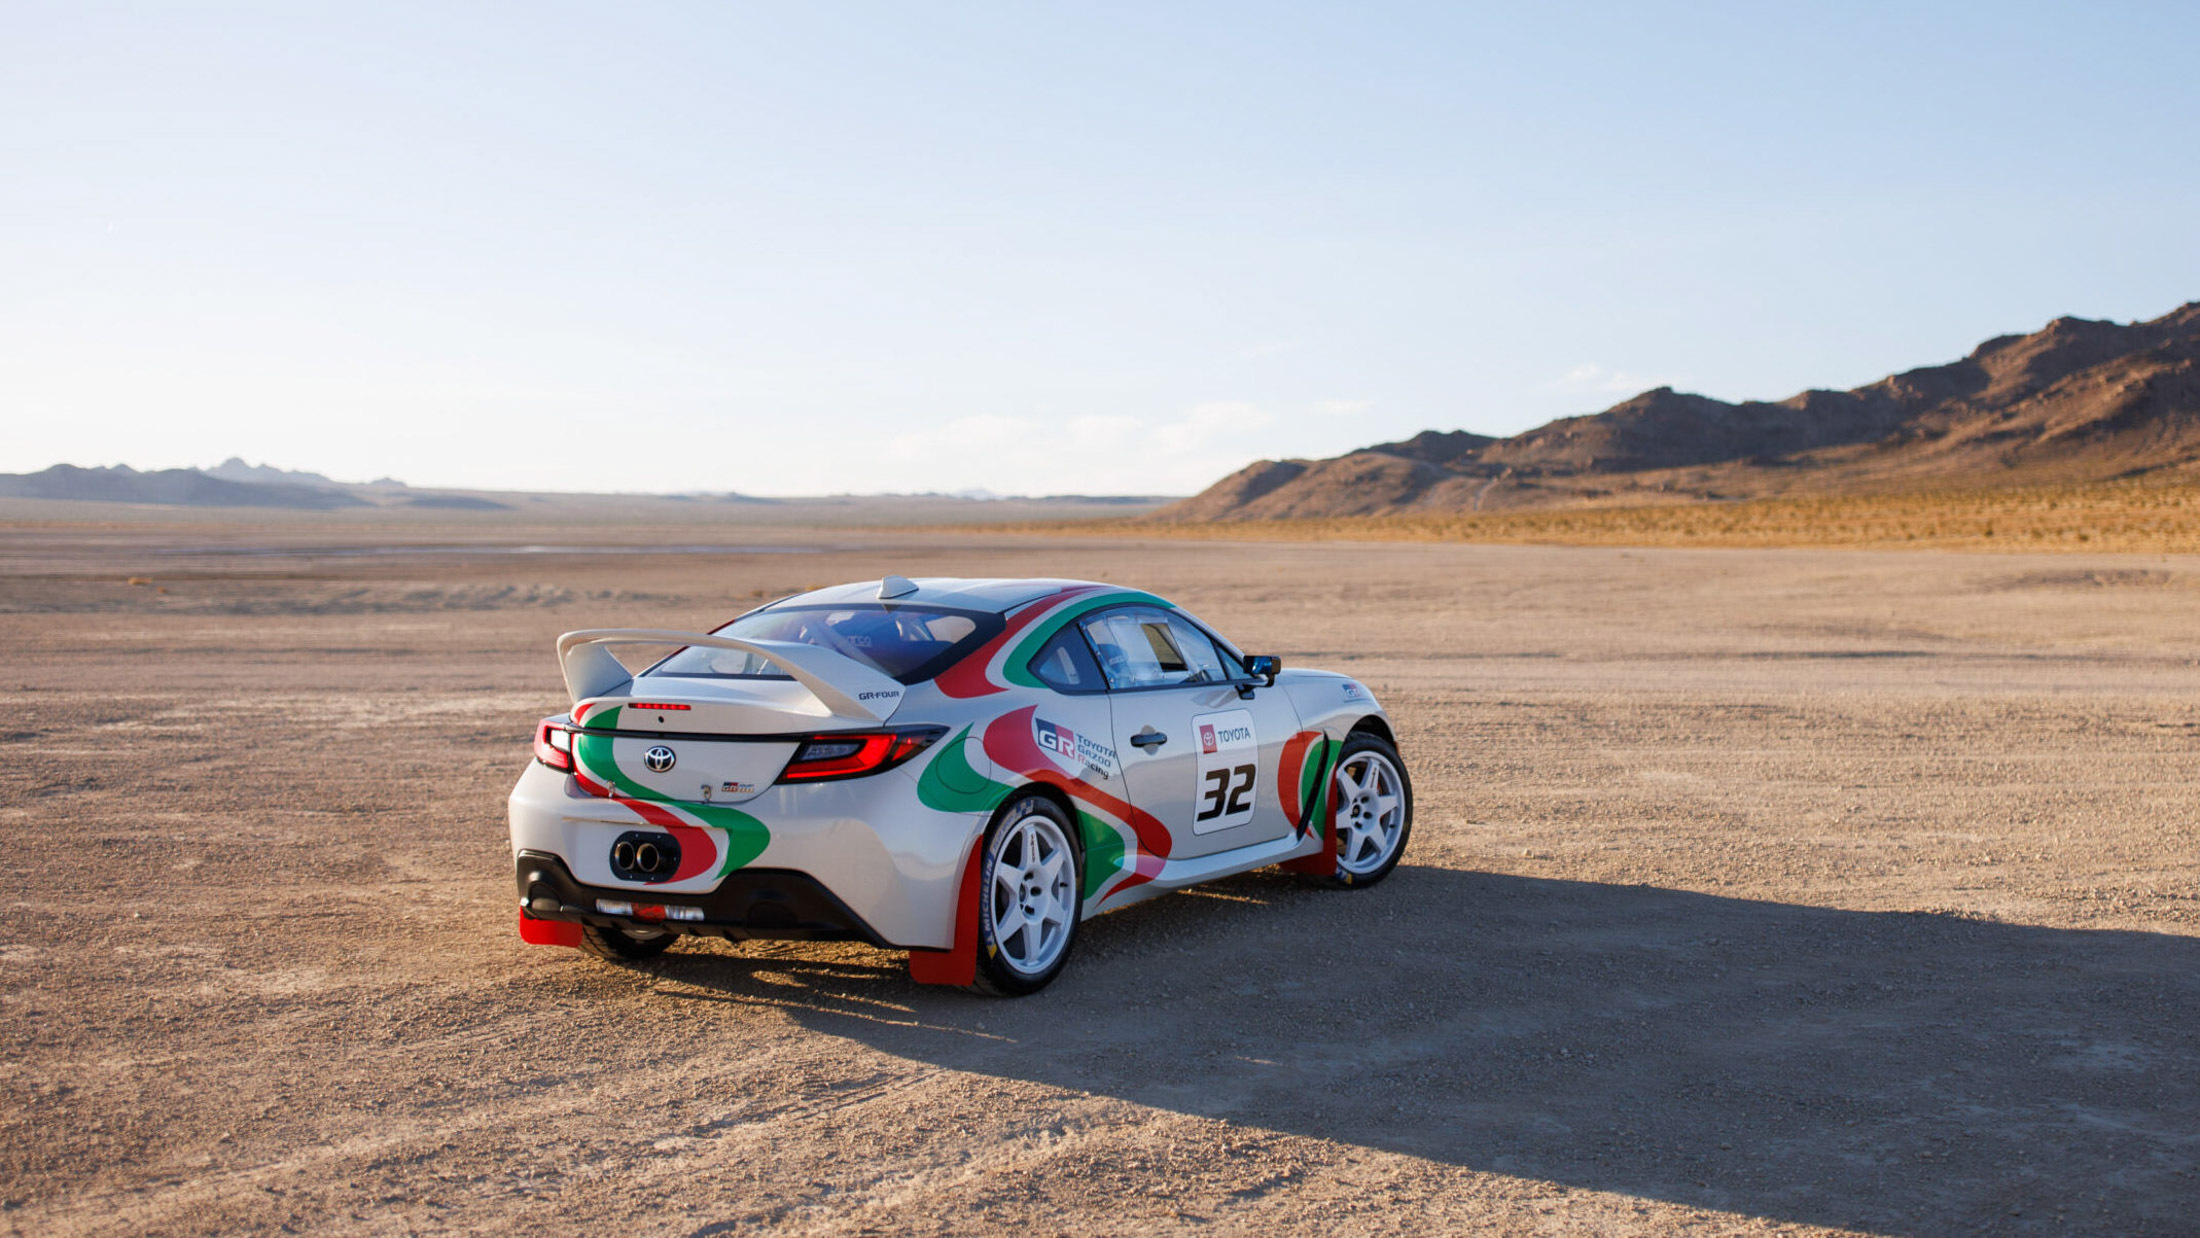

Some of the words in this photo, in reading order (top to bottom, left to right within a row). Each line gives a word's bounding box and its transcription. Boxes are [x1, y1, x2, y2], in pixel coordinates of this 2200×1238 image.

[858, 691, 900, 701] GR-FOUR
[1039, 729, 1074, 760] GR
[1076, 733, 1116, 759] TOYOTA
[1217, 727, 1251, 742] TOYOTA
[1077, 744, 1111, 768] GAZOO
[1077, 753, 1109, 780] Racing
[1196, 763, 1256, 822] 32
[982, 858, 993, 930] MICHELIN
